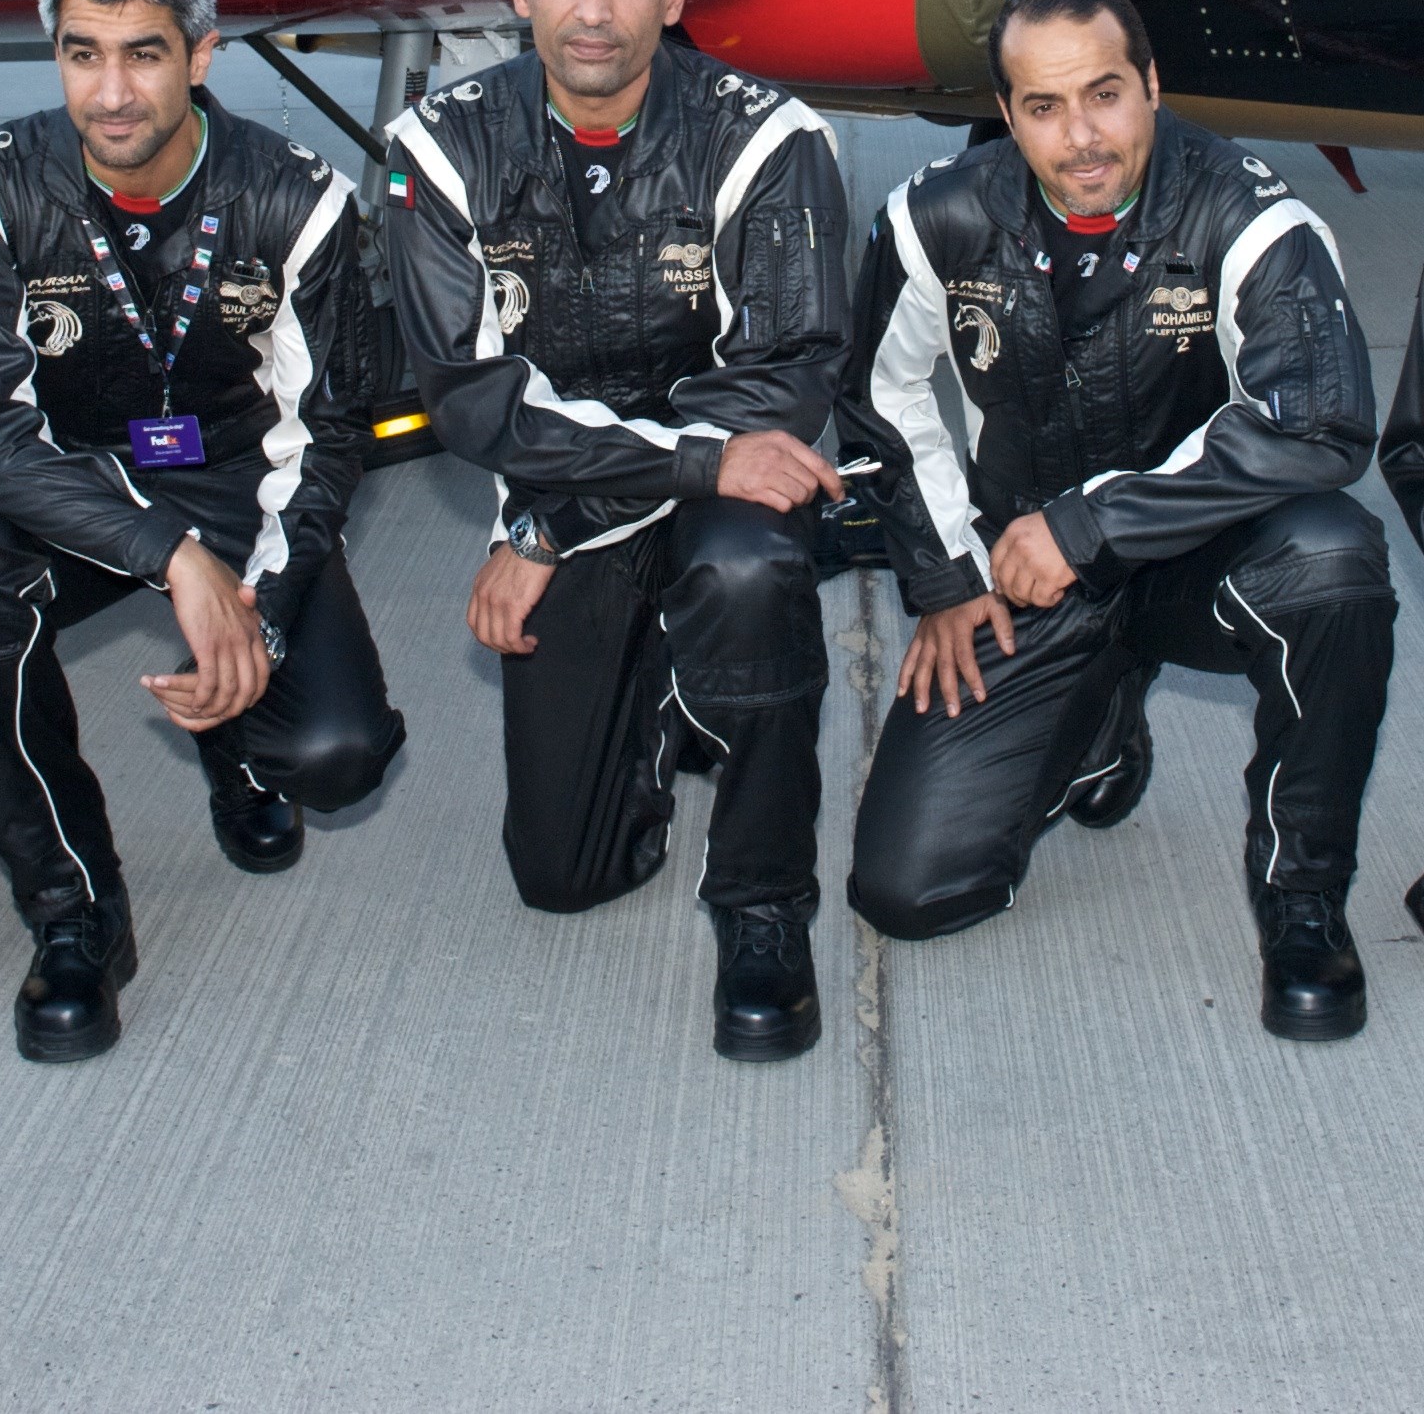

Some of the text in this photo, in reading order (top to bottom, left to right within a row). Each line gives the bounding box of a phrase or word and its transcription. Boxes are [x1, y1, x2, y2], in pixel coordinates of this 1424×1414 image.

[663, 267, 711, 282] NASSE
[675, 282, 709, 292] LEADER
[688, 294, 697, 310] 1
[1152, 310, 1212, 326] MOHAMED
[1156, 328, 1176, 336] LEFT
[1176, 336, 1190, 353] 2
[150, 434, 179, 446] FedEx
